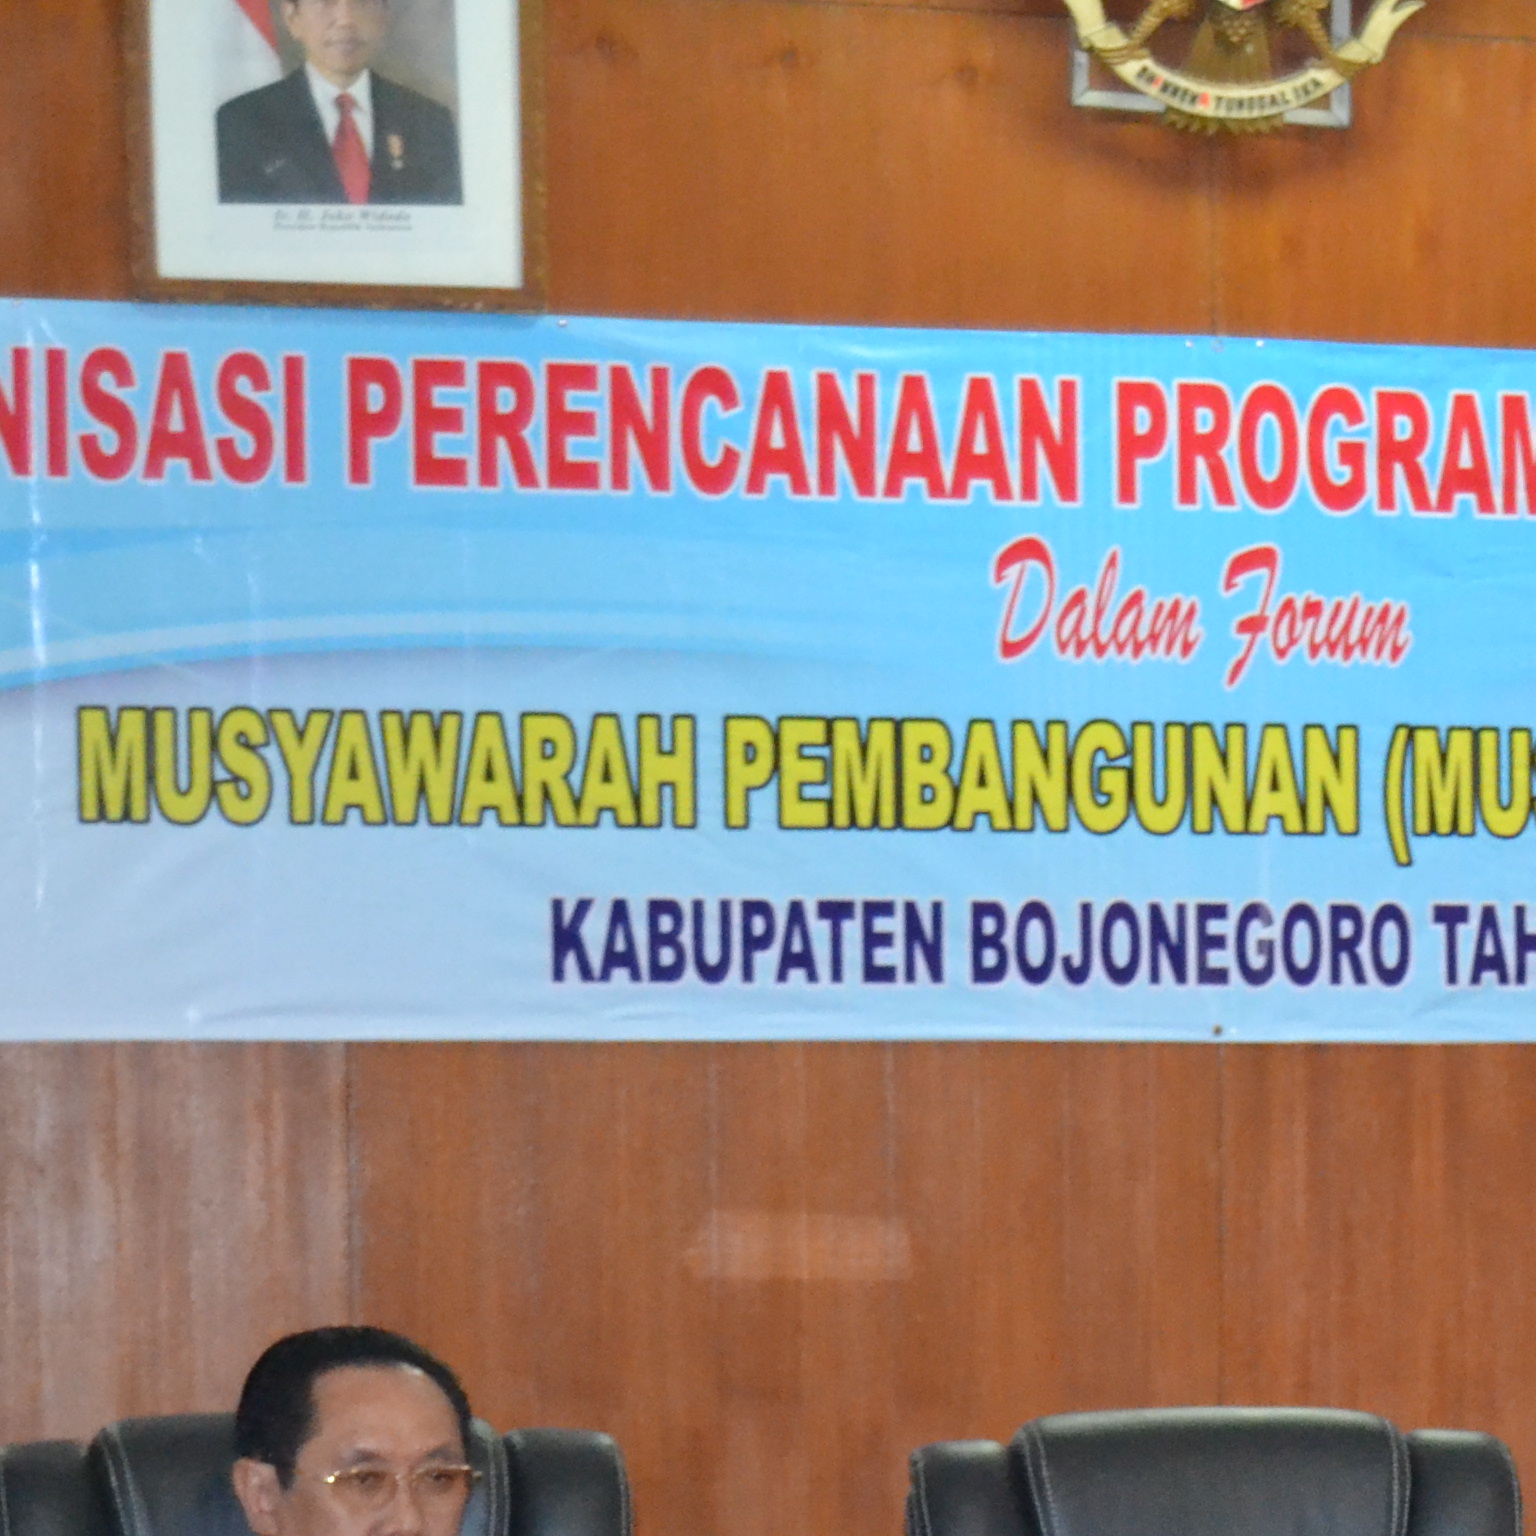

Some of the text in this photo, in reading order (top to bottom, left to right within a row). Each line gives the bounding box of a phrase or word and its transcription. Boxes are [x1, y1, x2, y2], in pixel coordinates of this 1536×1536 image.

[0, 346, 307, 485] NISASI
[346, 356, 1080, 504] PERENCANAAN
[994, 536, 1411, 688] Dalam Forum
[77, 705, 697, 829] MUSYAWARAH
[723, 714, 1360, 836] PEMBANGUNAN
[551, 897, 944, 985] KABUPATEN
[970, 900, 1411, 987] BOJONEGORO
